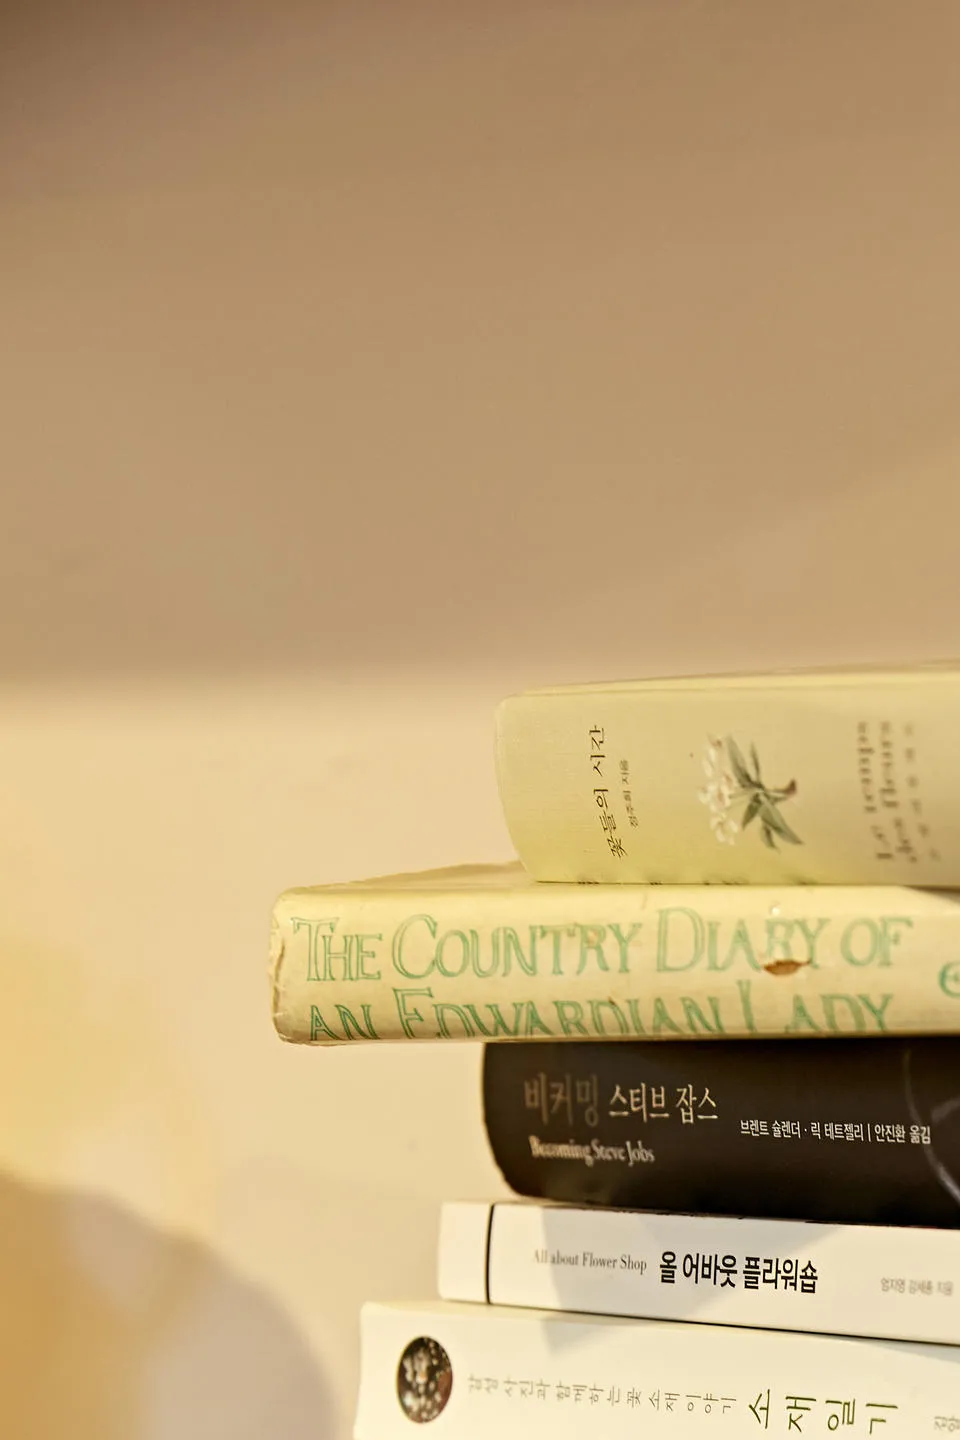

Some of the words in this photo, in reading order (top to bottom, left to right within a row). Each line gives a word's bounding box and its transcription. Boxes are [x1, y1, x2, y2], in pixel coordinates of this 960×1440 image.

[588, 725, 606, 778] 시간
[592, 788, 628, 859] 꽃들의
[290, 915, 381, 981] THE
[391, 913, 641, 980] COUNTRY
[838, 916, 914, 967] OF
[523, 1071, 601, 1128] 비커밍
[608, 1082, 672, 1124] 스티브
[675, 1083, 719, 1125] 잡스
[625, 1139, 655, 1167] Jobs
[740, 1119, 770, 1137] 브렌트
[771, 1120, 802, 1139] 슐렌더
[811, 1122, 821, 1139] 릭
[824, 1122, 864, 1141] 테트젤리
[874, 1124, 906, 1143] 안진환
[909, 1125, 931, 1145] 옮김
[550, 1250, 579, 1266] about
[582, 1252, 618, 1269] Flower
[619, 1253, 647, 1276] Shop
[659, 1251, 678, 1284] 올
[682, 1252, 738, 1288] 어바웃
[742, 1255, 819, 1294] 플라워숍
[625, 1387, 643, 1408] 꽃
[647, 1388, 682, 1414] 소재
[684, 1393, 738, 1416] 이야기
